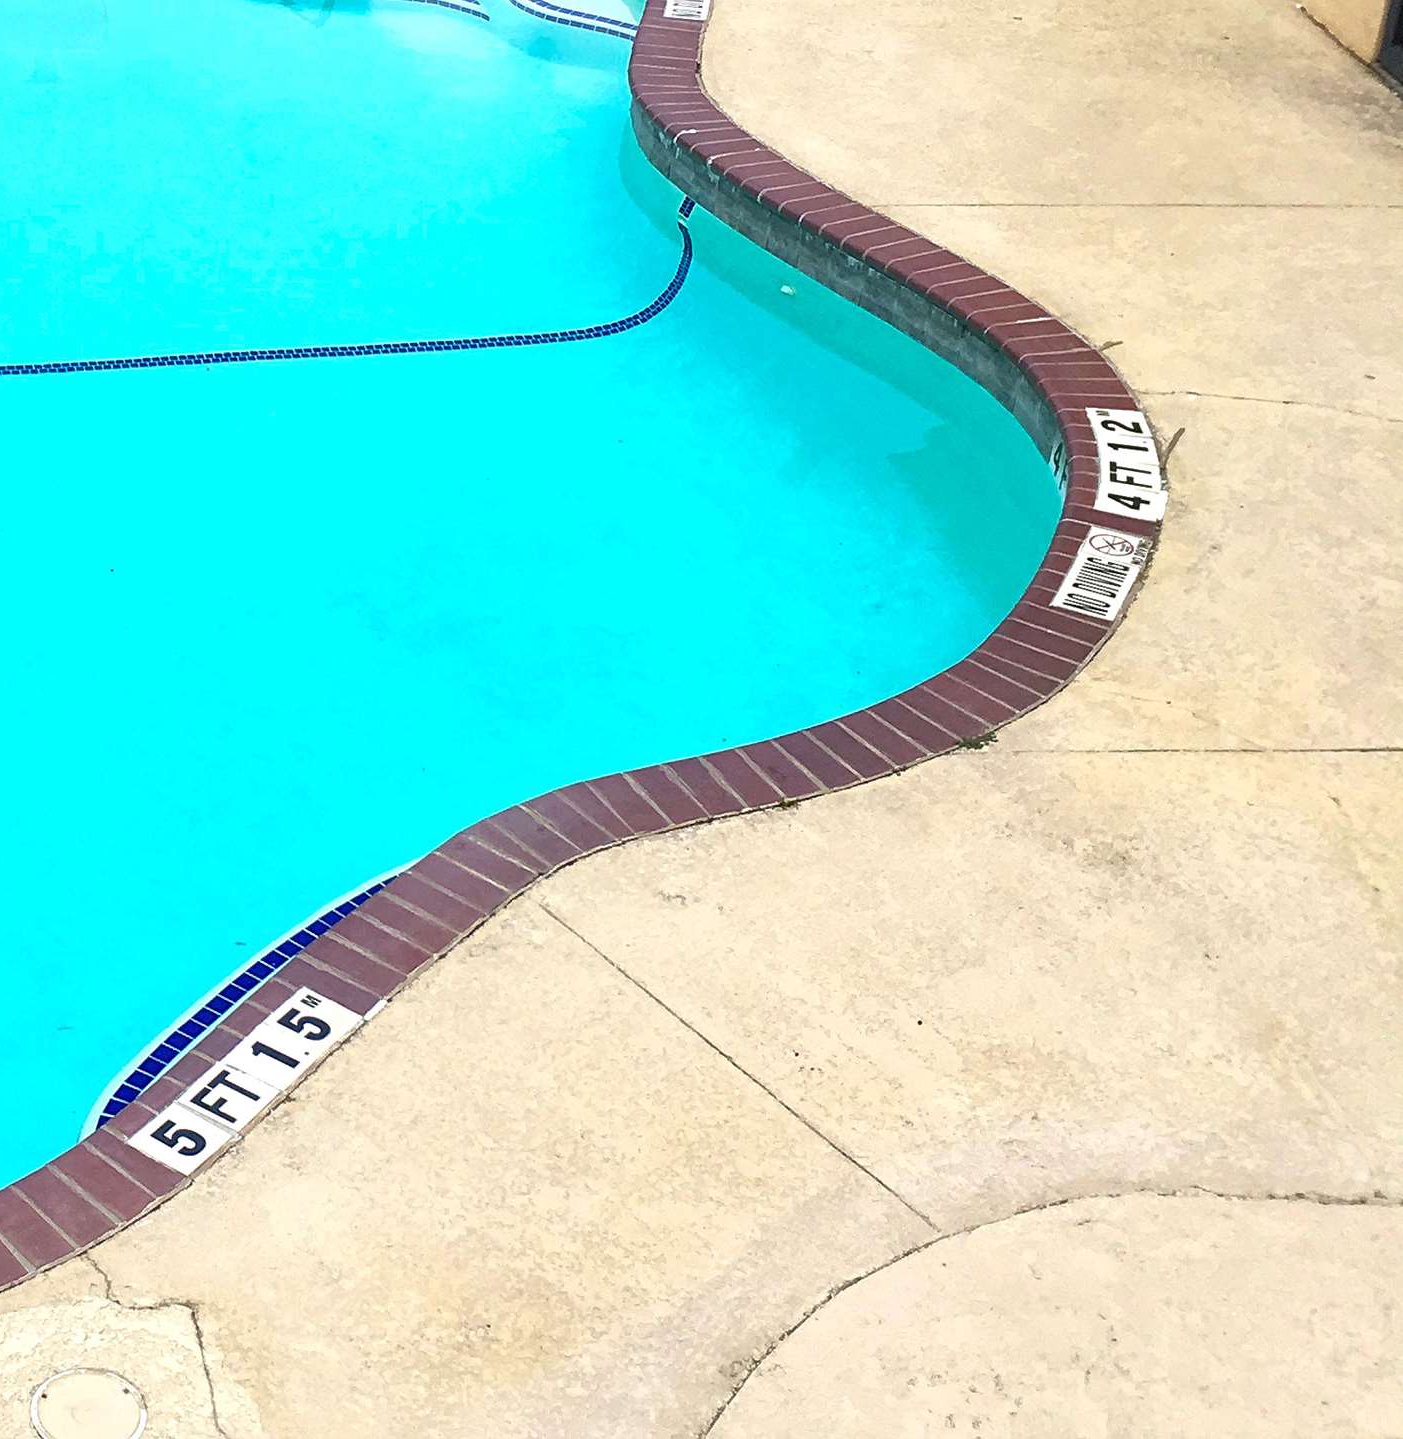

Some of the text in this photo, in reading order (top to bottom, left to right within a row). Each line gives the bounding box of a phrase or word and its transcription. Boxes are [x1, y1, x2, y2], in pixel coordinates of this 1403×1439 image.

[1109, 461, 1153, 488] FT
[1107, 492, 1151, 511] 4
[1062, 557, 1130, 616] NO DIVING
[150, 1120, 207, 1156] 5
[190, 1070, 260, 1124] FT
